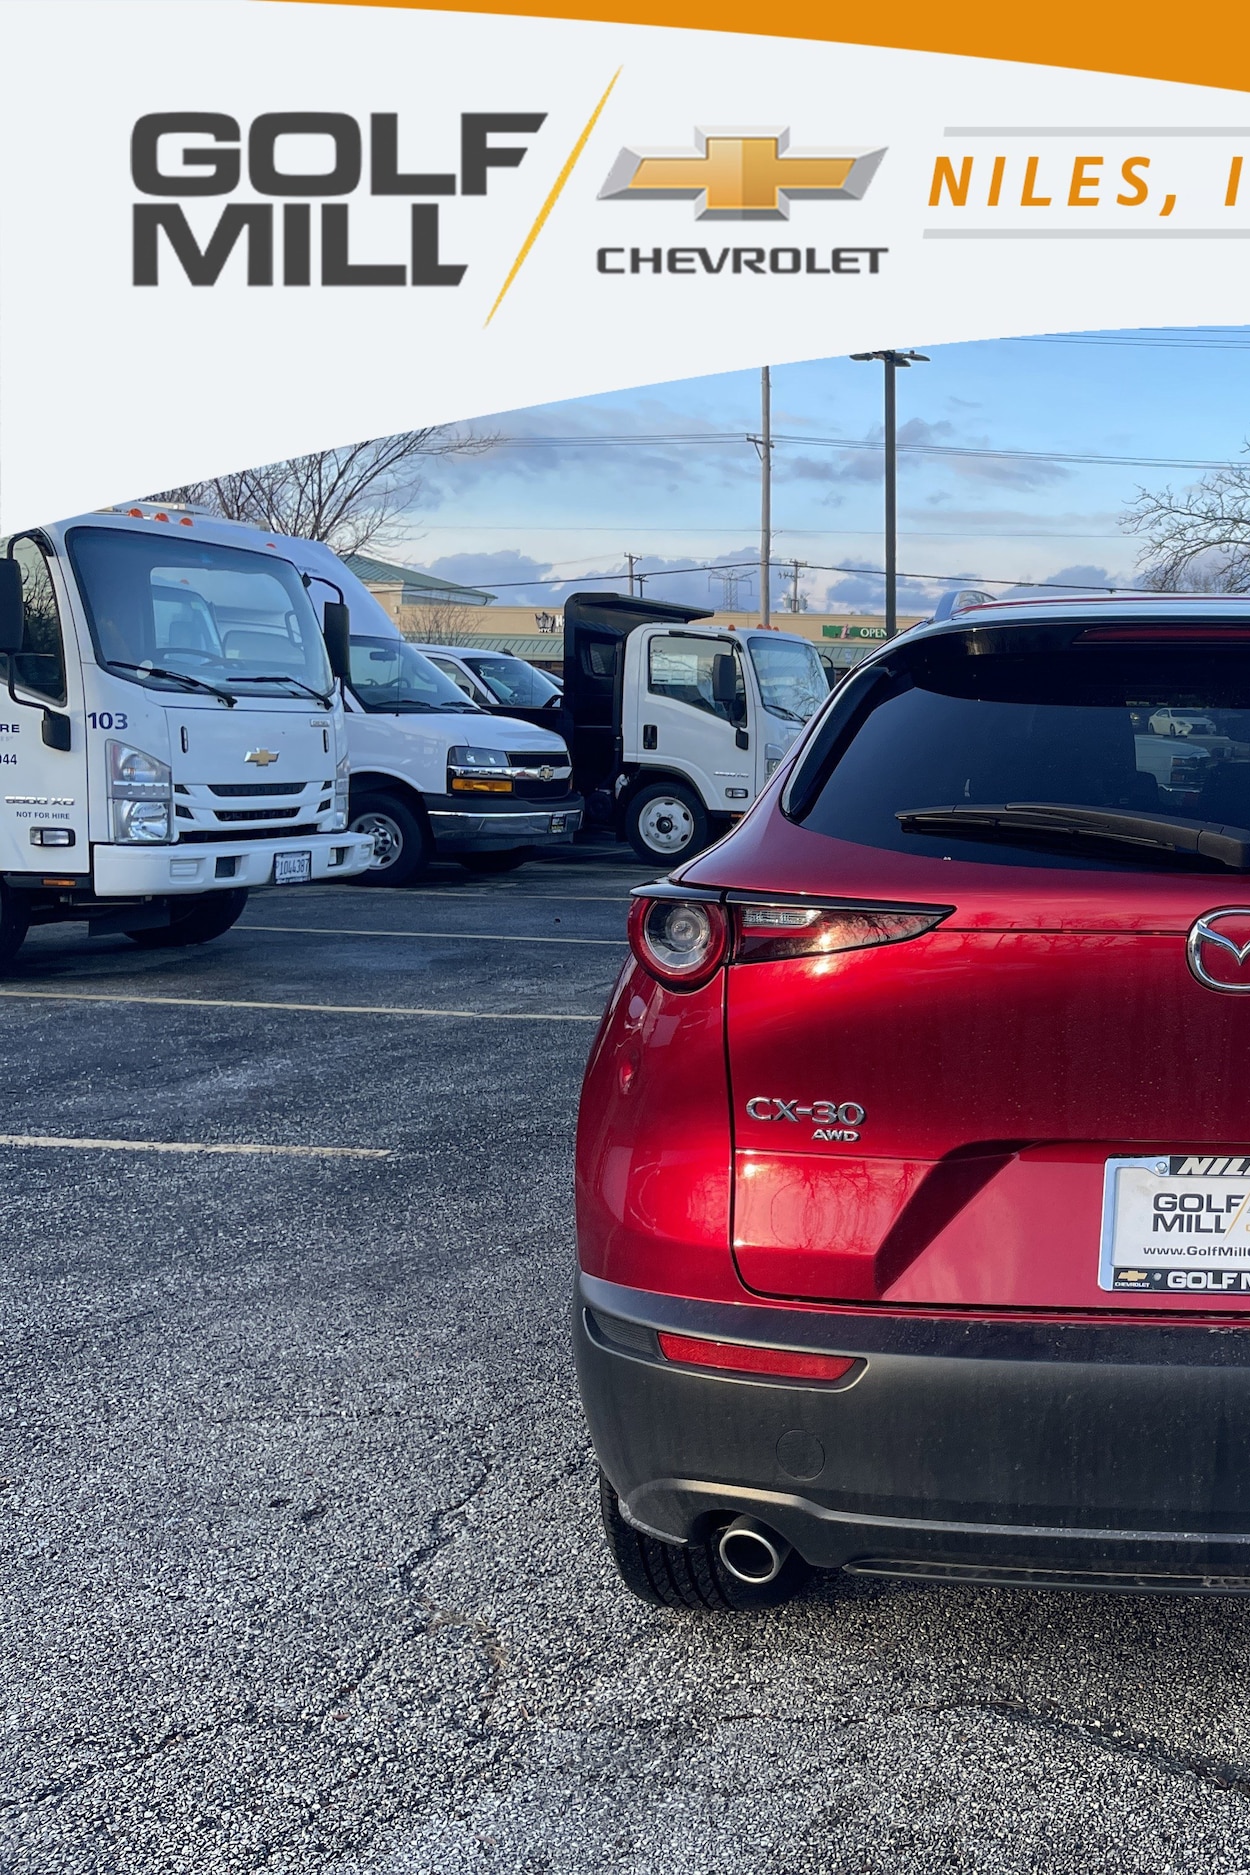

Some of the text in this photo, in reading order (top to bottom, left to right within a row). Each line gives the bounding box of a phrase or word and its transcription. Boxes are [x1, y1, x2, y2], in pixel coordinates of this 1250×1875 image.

[860, 628, 887, 638] OPEN
[87, 711, 128, 730] 103
[52, 812, 71, 820] HIRE
[745, 1096, 867, 1126] CX-30
[811, 1129, 861, 1142] AWD
[1152, 1192, 1245, 1213] GOLF
[1152, 1213, 1227, 1234] MILL
[1166, 1271, 1239, 1289] GOLF
